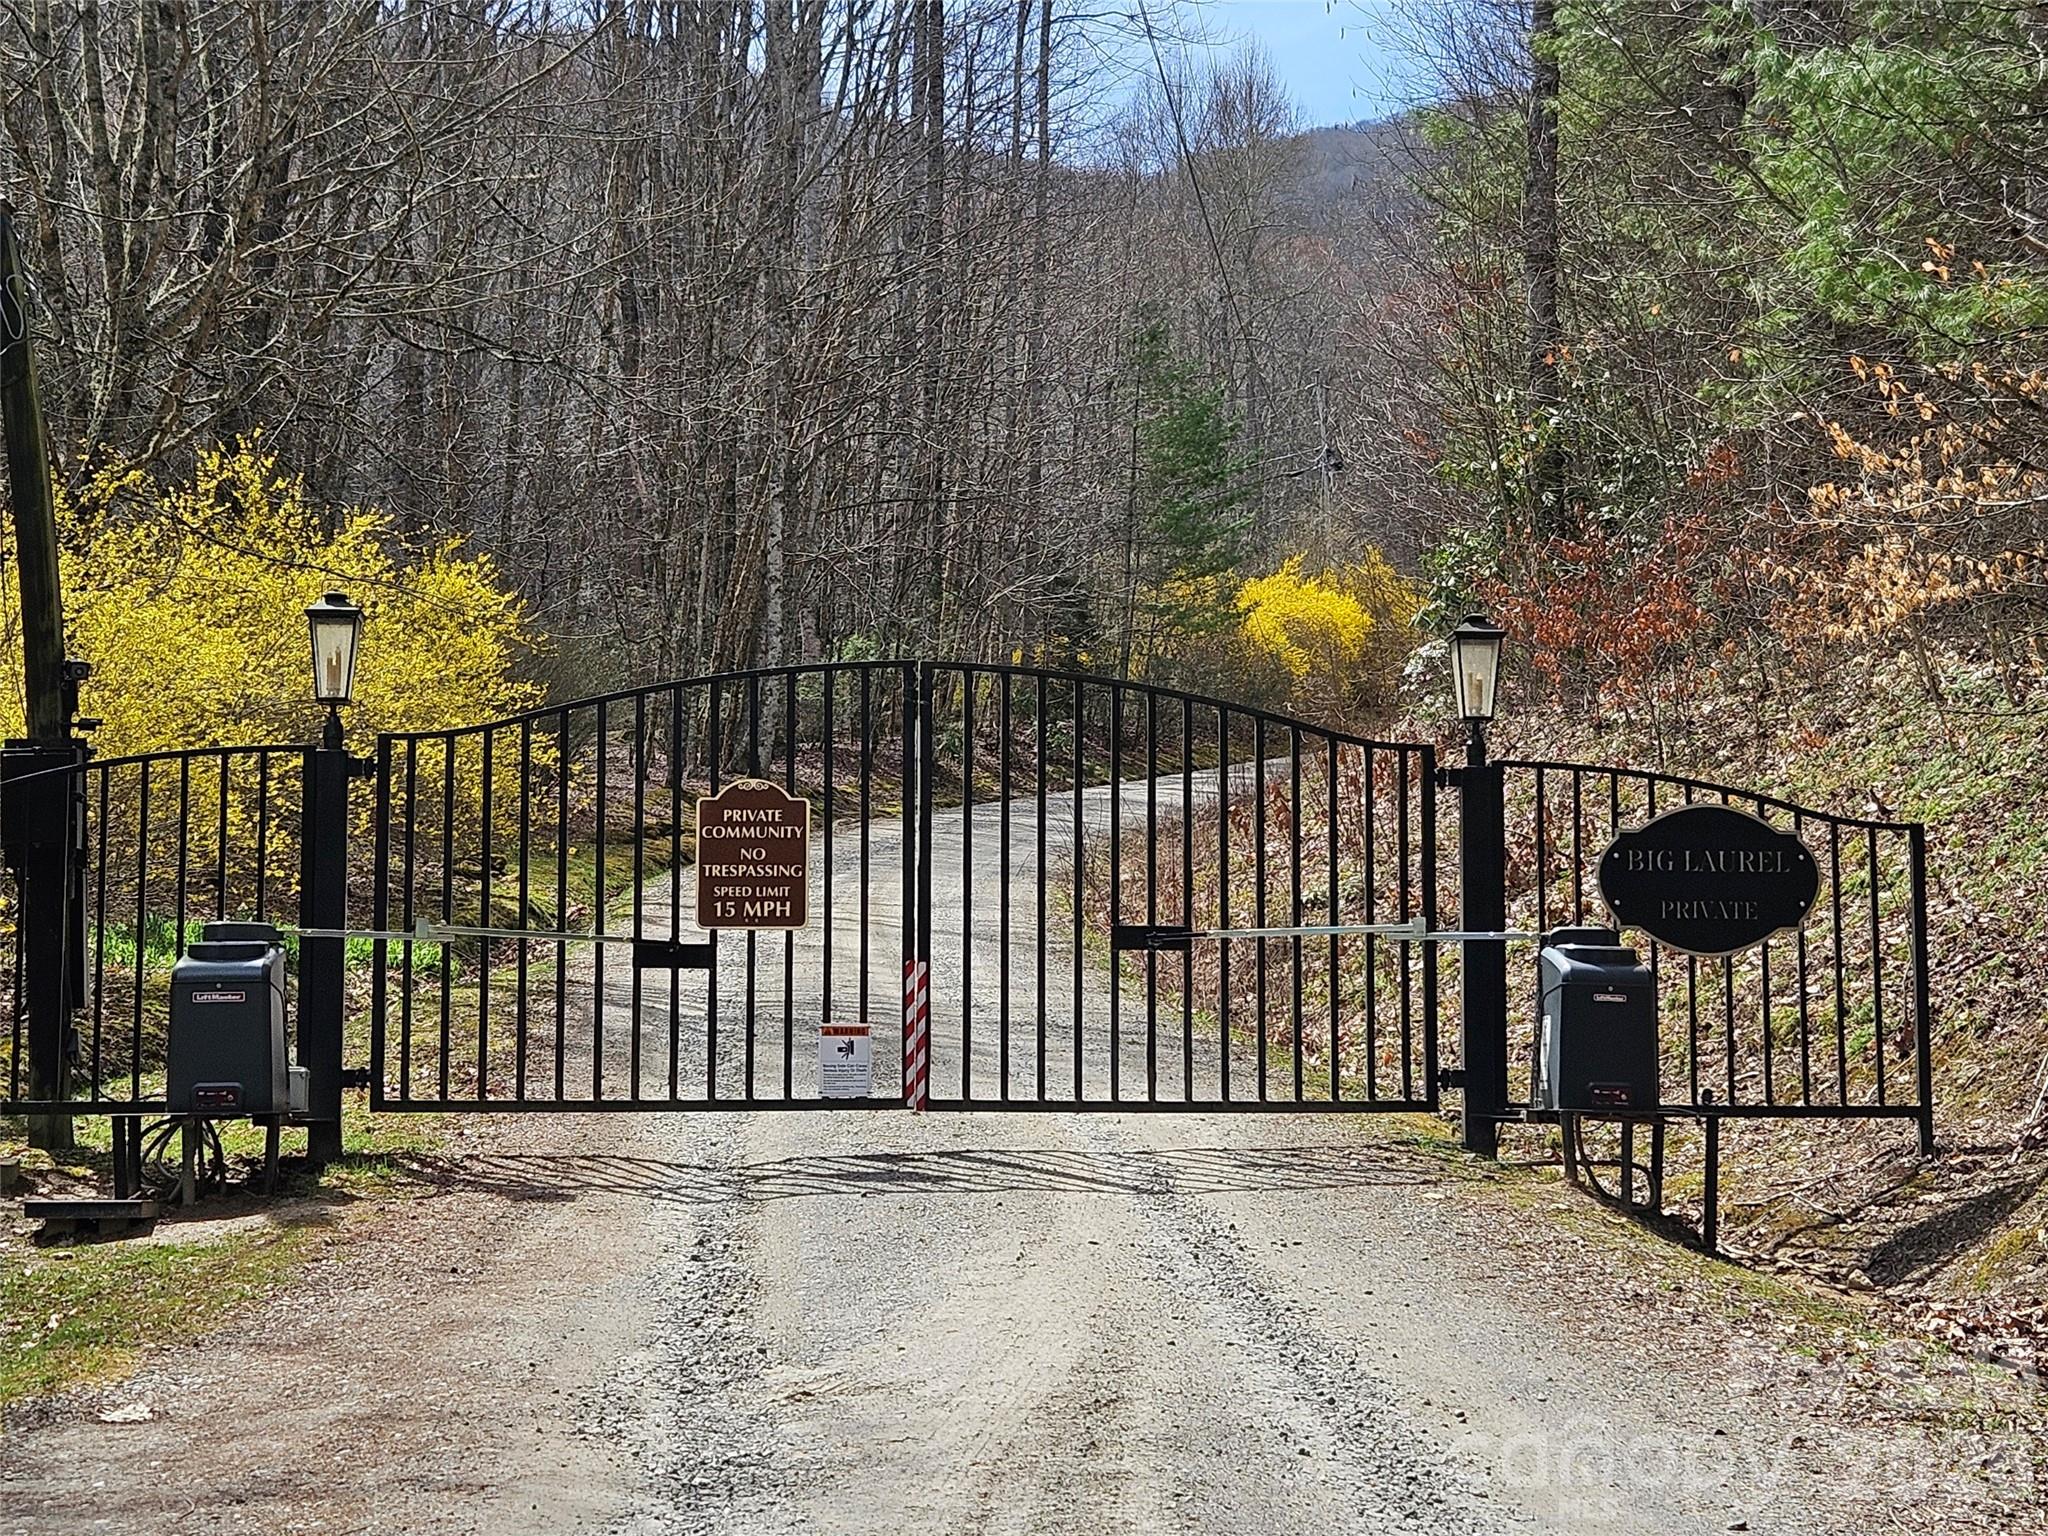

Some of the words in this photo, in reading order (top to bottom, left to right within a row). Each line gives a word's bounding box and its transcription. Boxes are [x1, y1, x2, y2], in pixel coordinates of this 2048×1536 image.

[723, 809, 783, 823] PRIVATE
[701, 825, 804, 839] COMMUNITY
[740, 848, 766, 860] NO
[1627, 849, 1674, 872] BIG
[1684, 850, 1790, 873] LAUREL
[702, 864, 803, 878] TRESPASSING
[713, 886, 752, 897] SPEED
[755, 886, 791, 897] LIMIT
[713, 901, 736, 917] 15
[743, 901, 791, 918] MPH
[1660, 899, 1759, 920] PRIVATE
